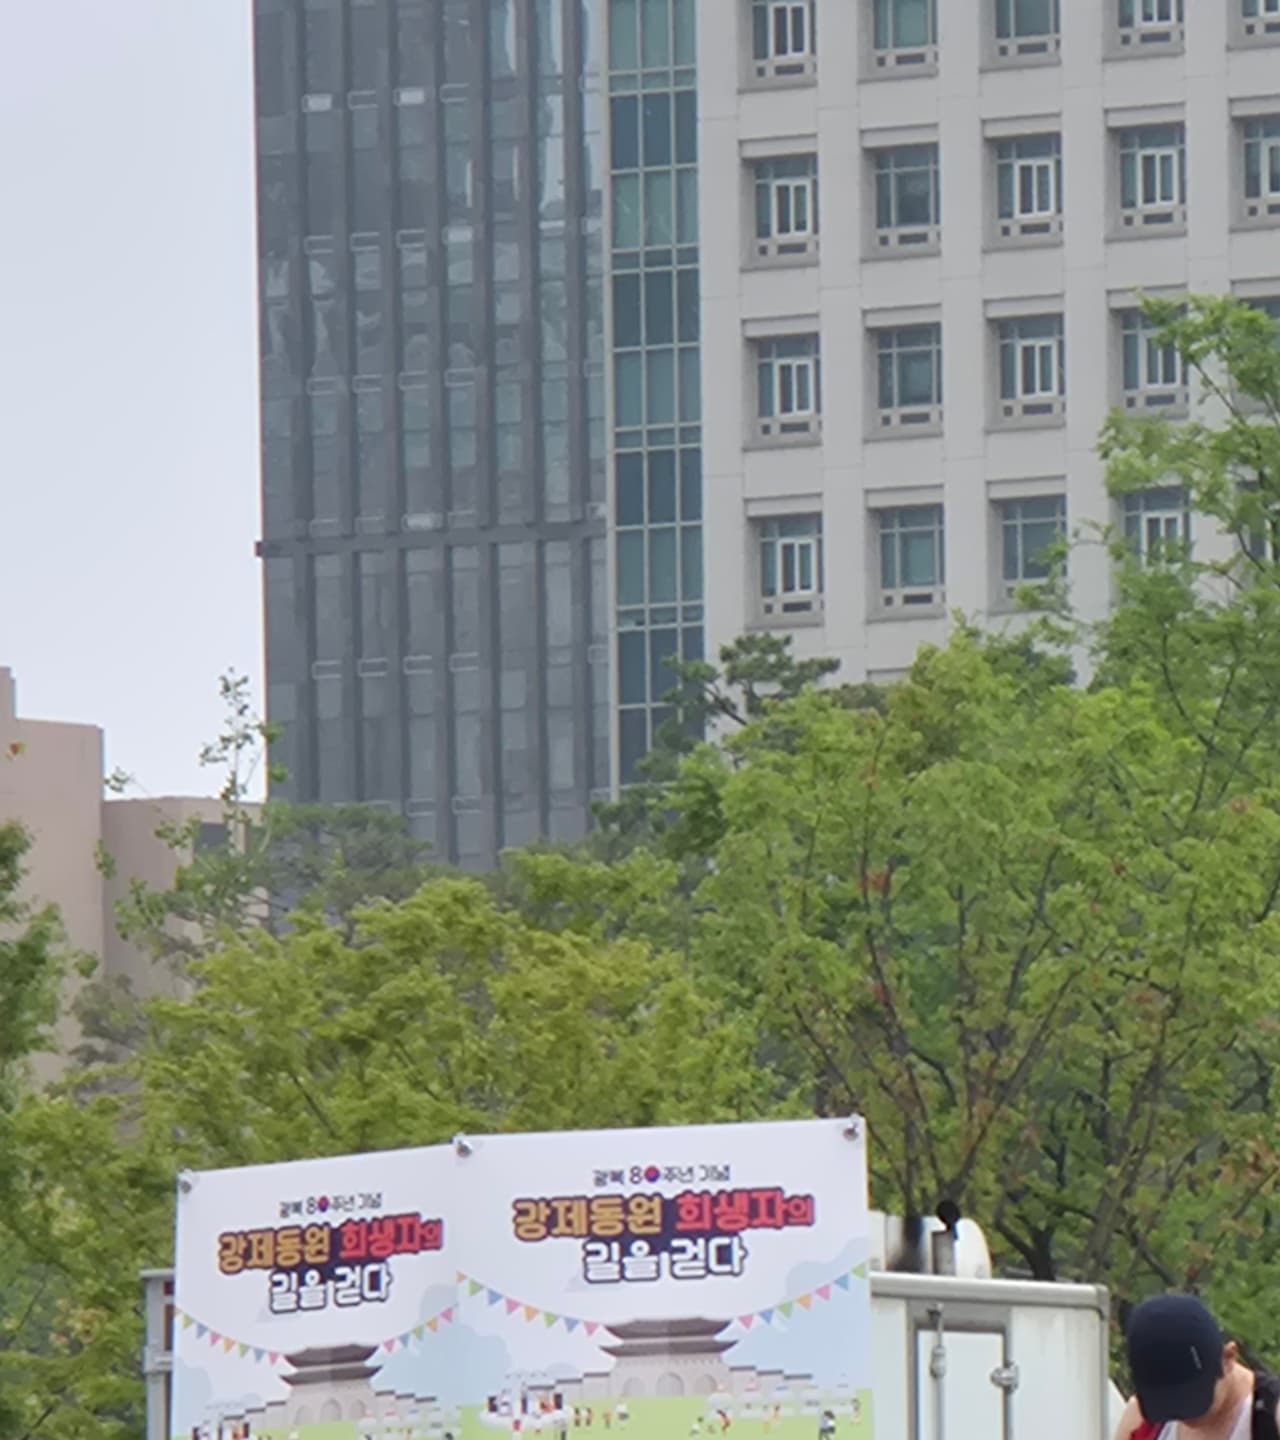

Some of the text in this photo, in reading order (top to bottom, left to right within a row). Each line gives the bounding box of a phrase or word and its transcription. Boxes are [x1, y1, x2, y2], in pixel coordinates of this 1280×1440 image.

[593, 1170, 624, 1186] 광복
[699, 1165, 730, 1181] 기념
[280, 1202, 302, 1217] 광복
[358, 1193, 382, 1209] 기념
[515, 1190, 813, 1239] 강제동원 희생자의
[219, 1215, 441, 1272] 강제동원 희생자의
[585, 1235, 745, 1282] 길을 걷다
[272, 1264, 391, 1312] 길을 걷다
